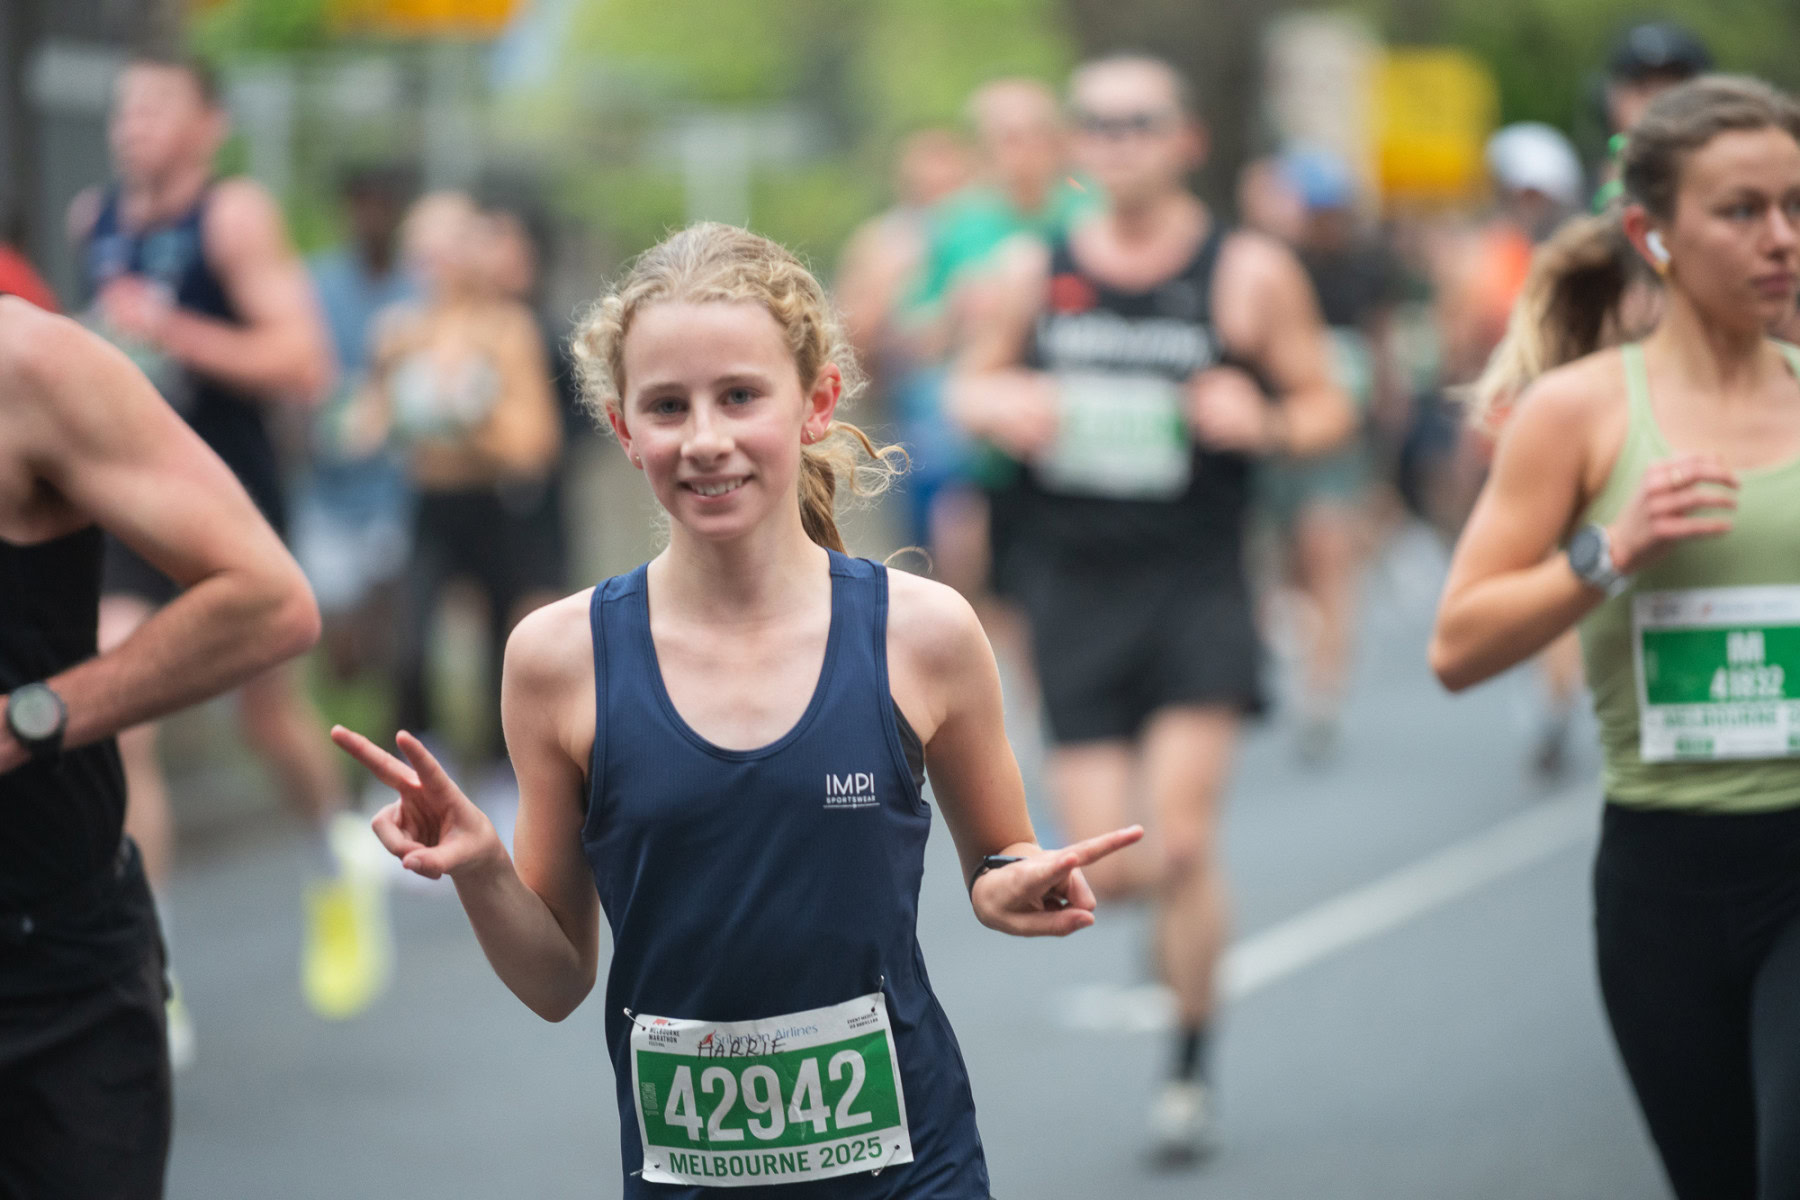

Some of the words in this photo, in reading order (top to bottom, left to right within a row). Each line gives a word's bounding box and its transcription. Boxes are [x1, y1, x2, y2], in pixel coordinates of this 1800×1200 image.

[826, 772, 875, 796] IMPI
[826, 795, 876, 804] SPORTSWEAR
[648, 1034, 678, 1044] MARATHON
[775, 1024, 818, 1040] Airlines
[697, 1034, 786, 1061] HARRIE
[664, 1049, 873, 1142] 42942
[669, 1151, 811, 1178] MELBOURNE
[819, 1136, 883, 1169] 2025
